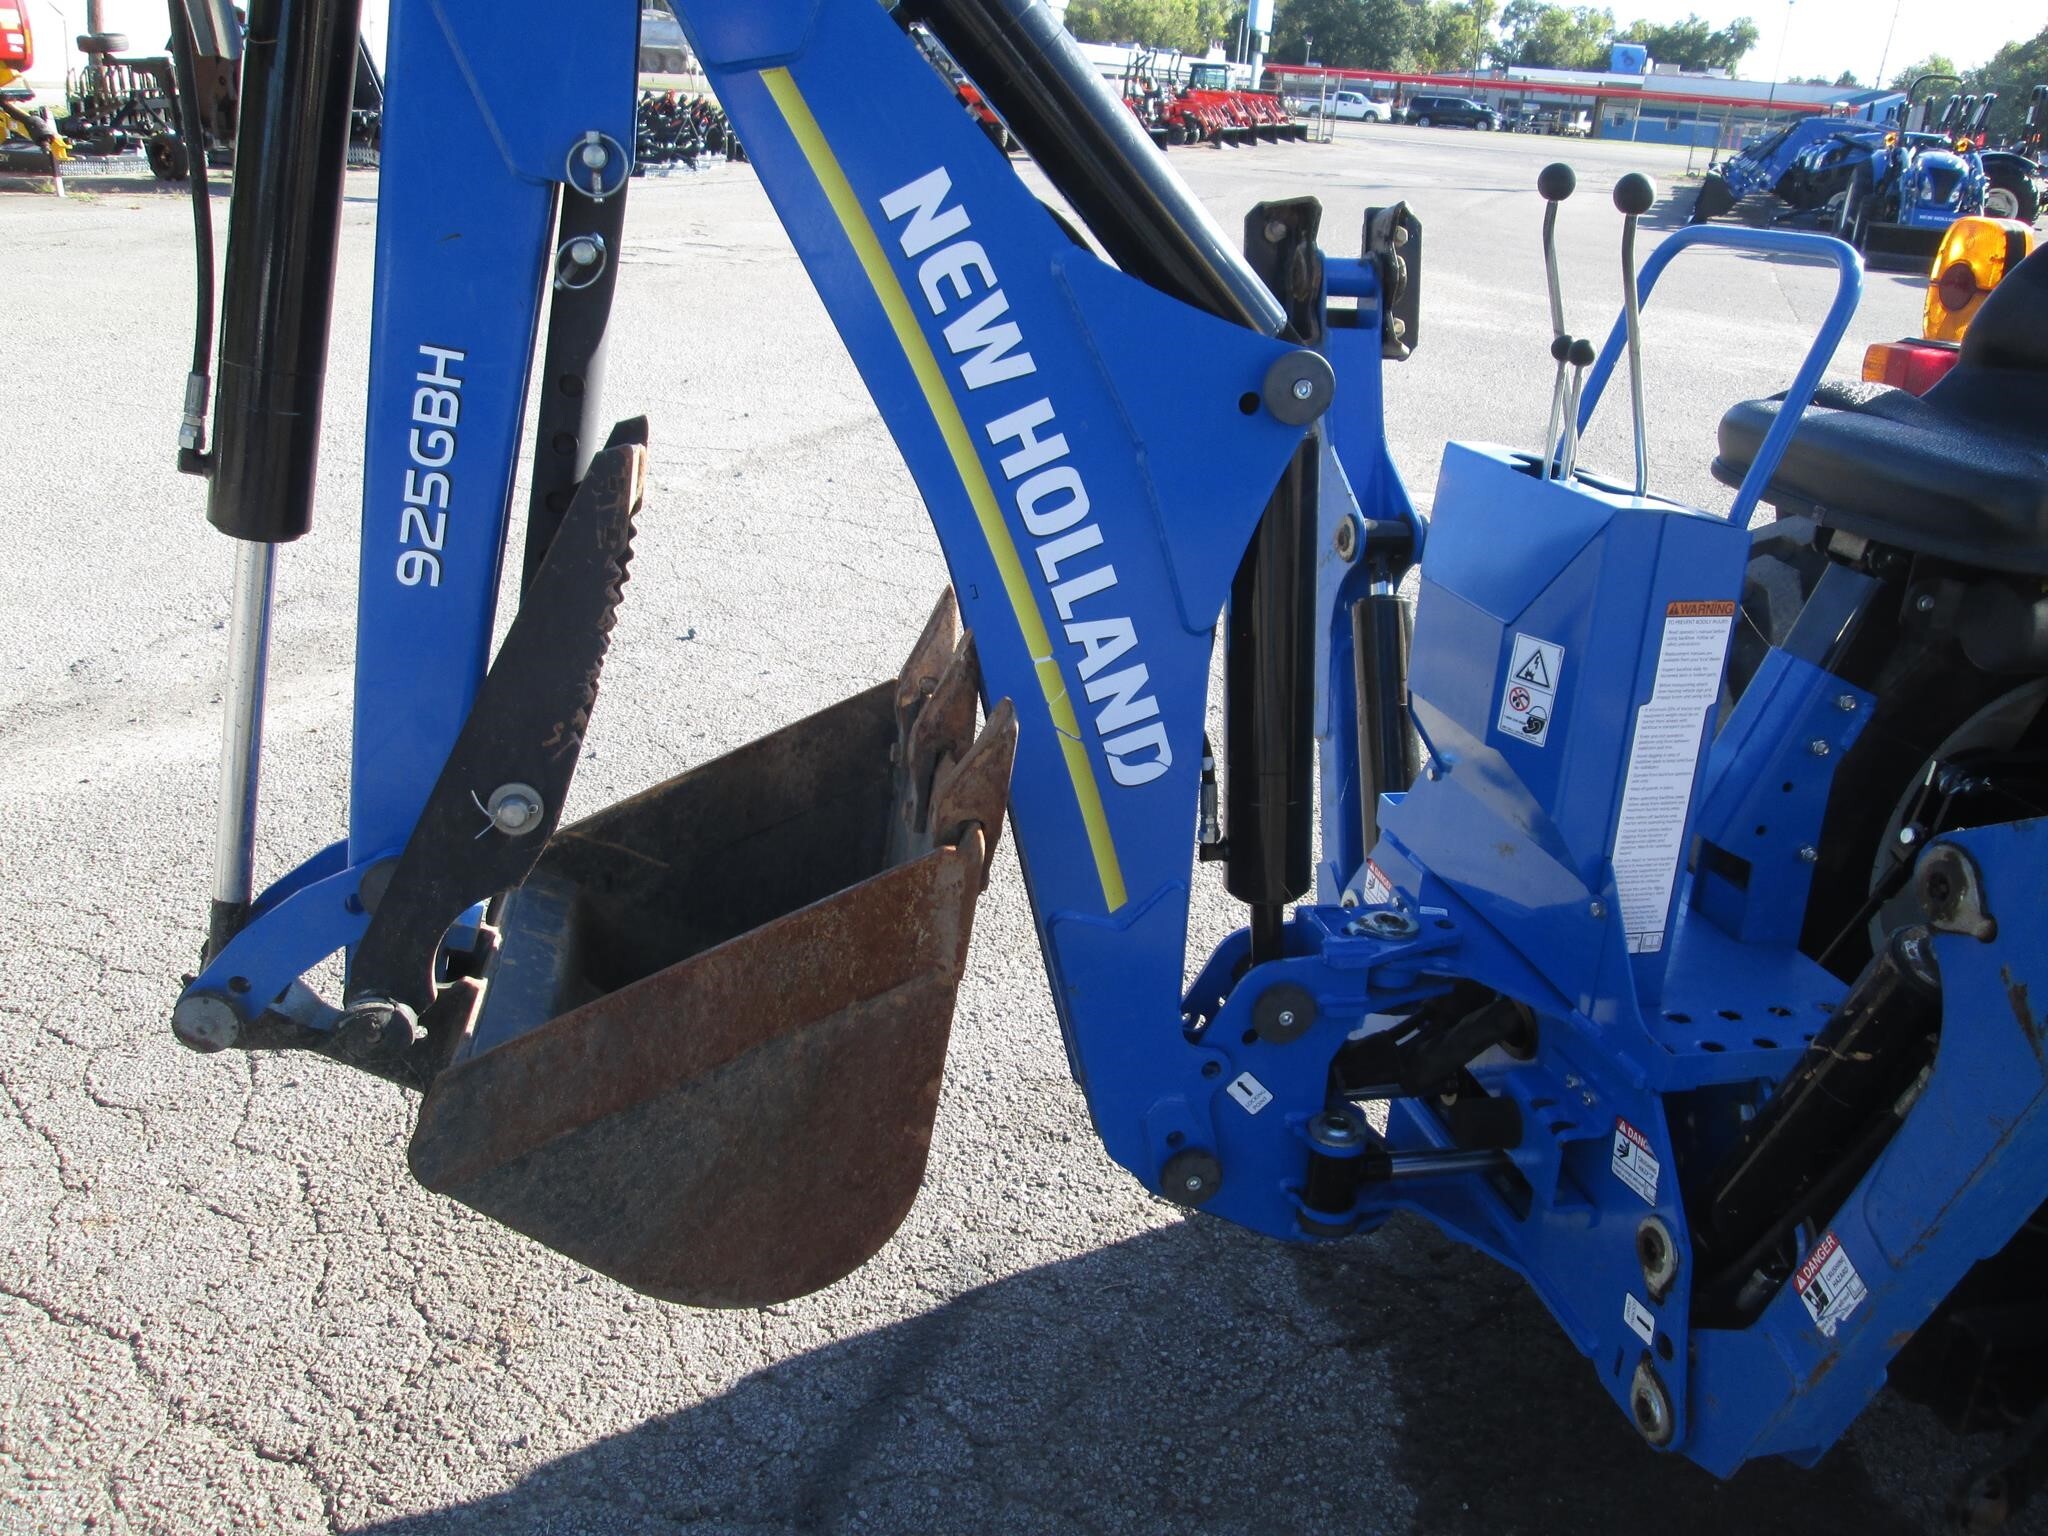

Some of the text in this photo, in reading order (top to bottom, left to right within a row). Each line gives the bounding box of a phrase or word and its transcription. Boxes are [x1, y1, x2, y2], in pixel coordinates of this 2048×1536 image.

[396, 344, 466, 588] 925GBH
[879, 165, 1173, 787] NEW HOLLAND
[1680, 603, 1733, 615] WARNING
[1803, 1235, 1836, 1278] DANGER
